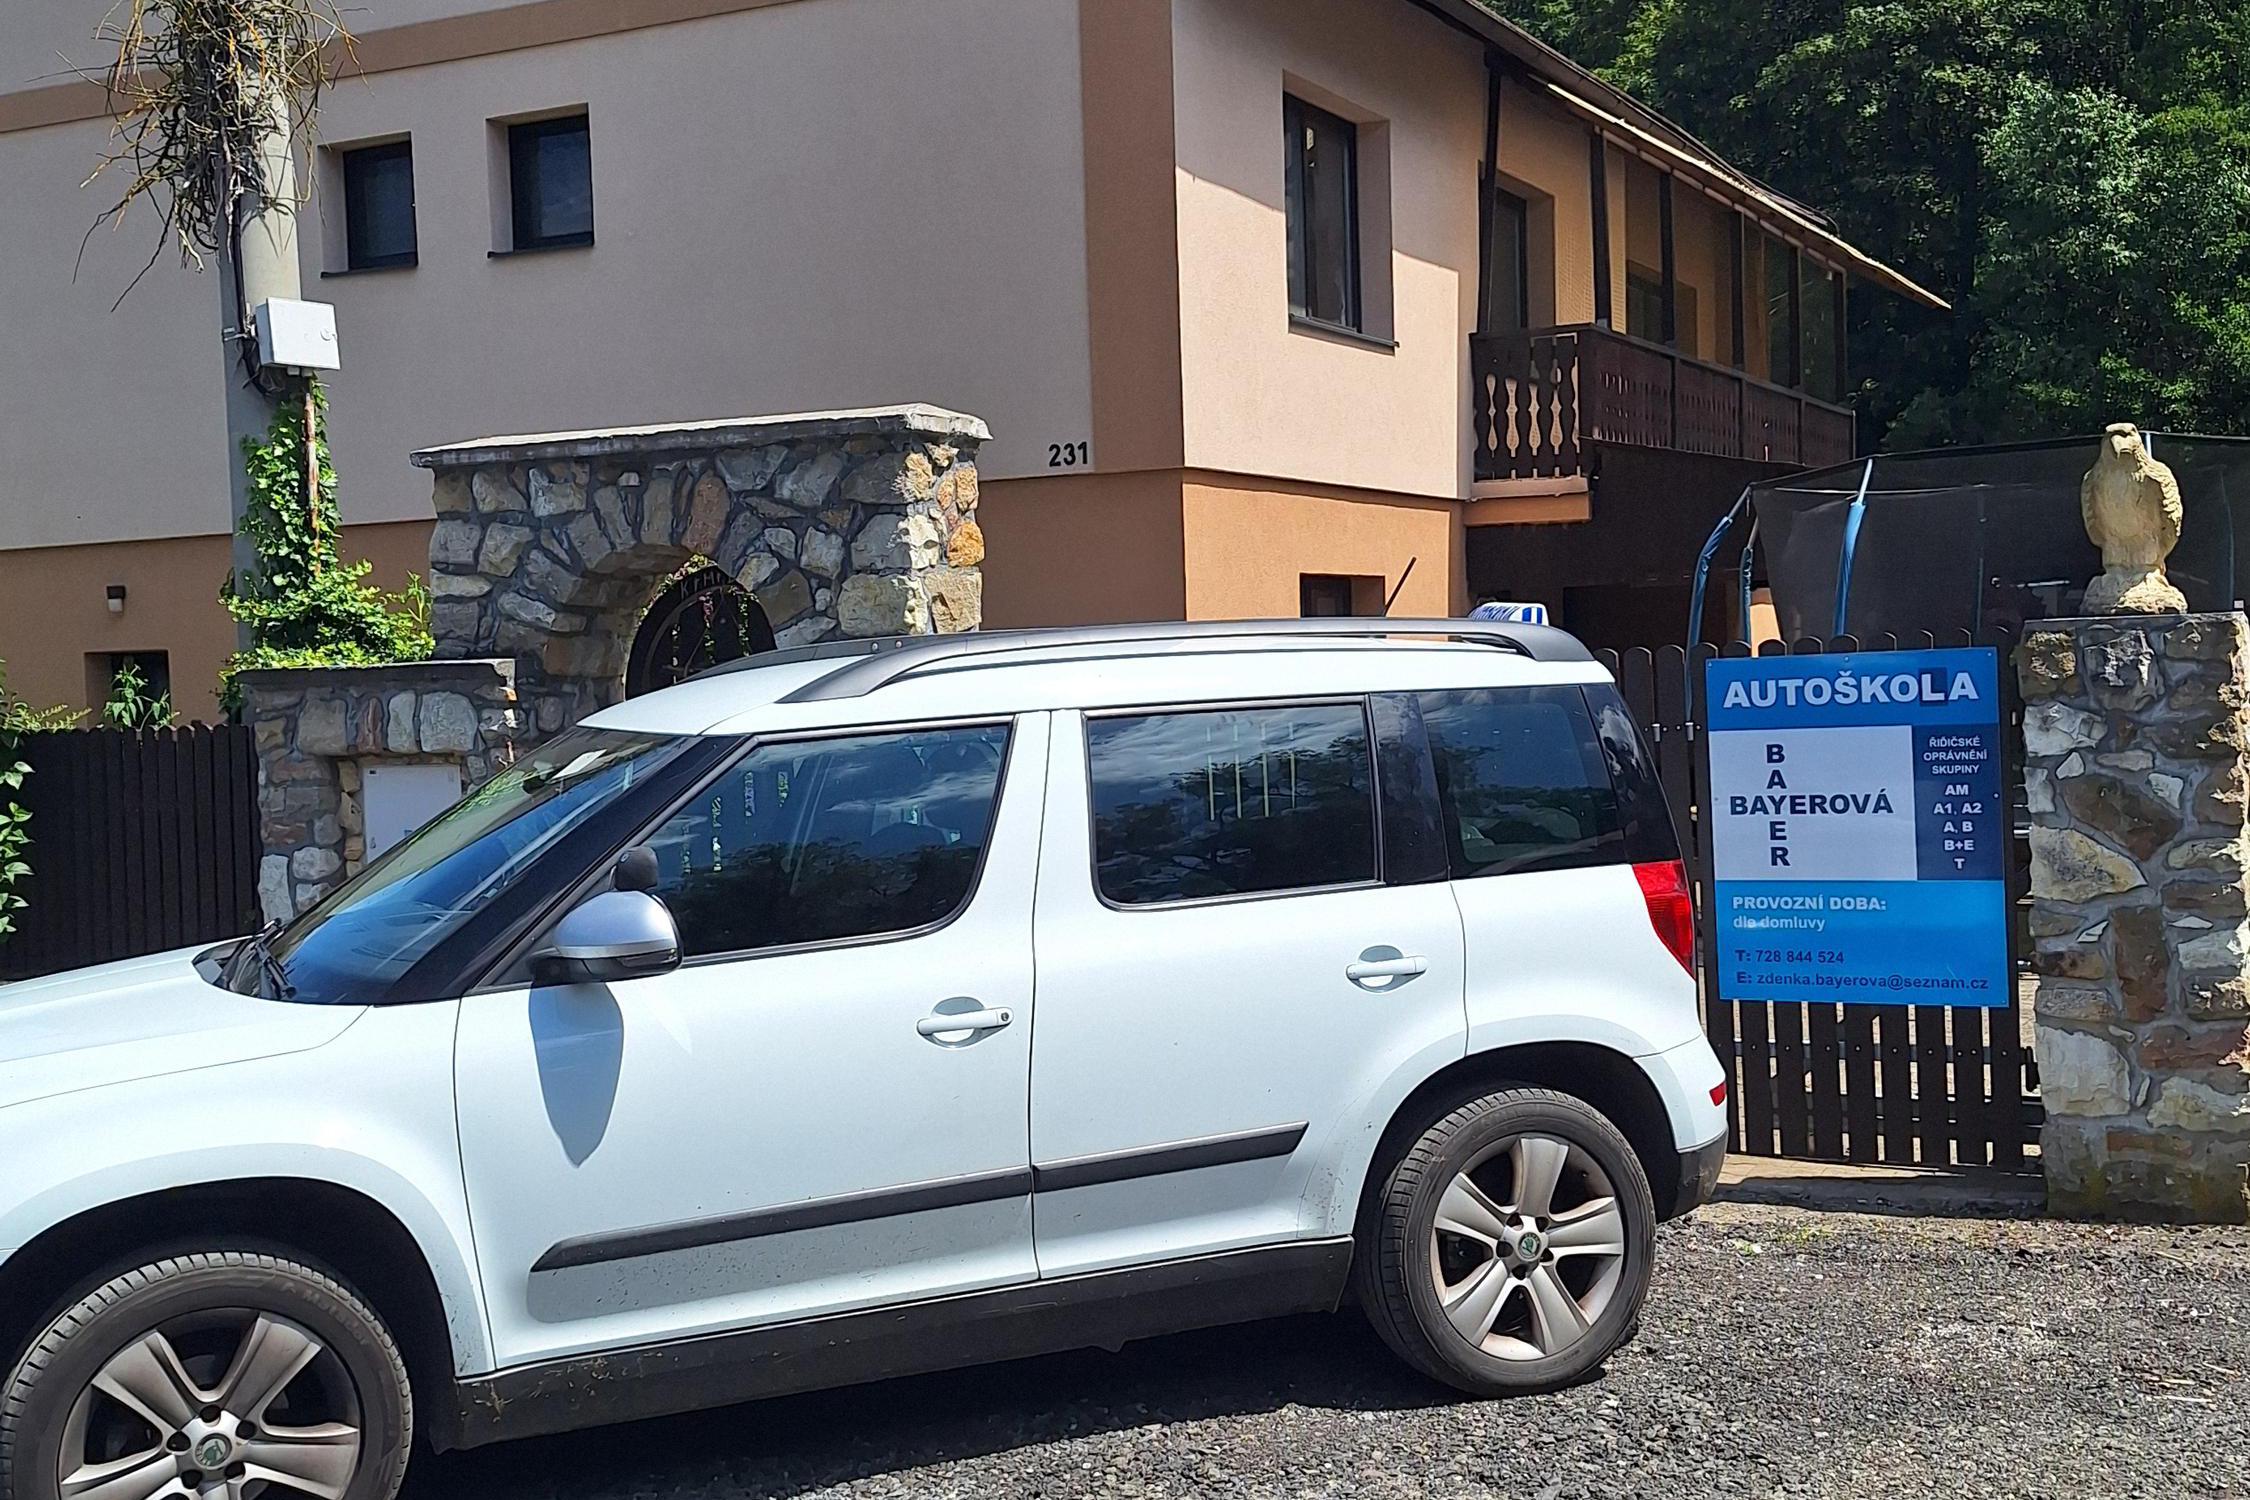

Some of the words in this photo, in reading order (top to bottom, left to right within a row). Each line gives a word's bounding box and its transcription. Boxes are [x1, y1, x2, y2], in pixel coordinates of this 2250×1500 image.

[1048, 441, 1088, 467] 231
[1723, 670, 1979, 708] AUTOŠKOLA
[1924, 749, 1987, 761] OPRÁVNĚNÍ
[1932, 765, 1979, 774] SKUPINY
[1945, 785, 1968, 795] AM
[1730, 788, 1894, 815] BAYEROVÁ
[1934, 803, 1957, 815] A1,
[1962, 803, 1982, 813] A2
[1944, 822, 1958, 833] A,
[1962, 821, 1973, 832] B
[1945, 840, 1974, 850] B+E
[1954, 858, 1965, 869] T
[1733, 895, 1824, 909] PROVOZNÍ
[1830, 897, 1886, 910] DOBA:
[1733, 916, 1756, 928] dle
[1760, 917, 1826, 931] domluvy
[1735, 950, 1751, 962] T:
[1756, 950, 1780, 962] 728
[1786, 951, 1812, 963] 844
[1818, 951, 1844, 963] 524
[1737, 971, 1752, 984] E:
[1757, 973, 1988, 990] zdenka.bayerova@seznam.cz
